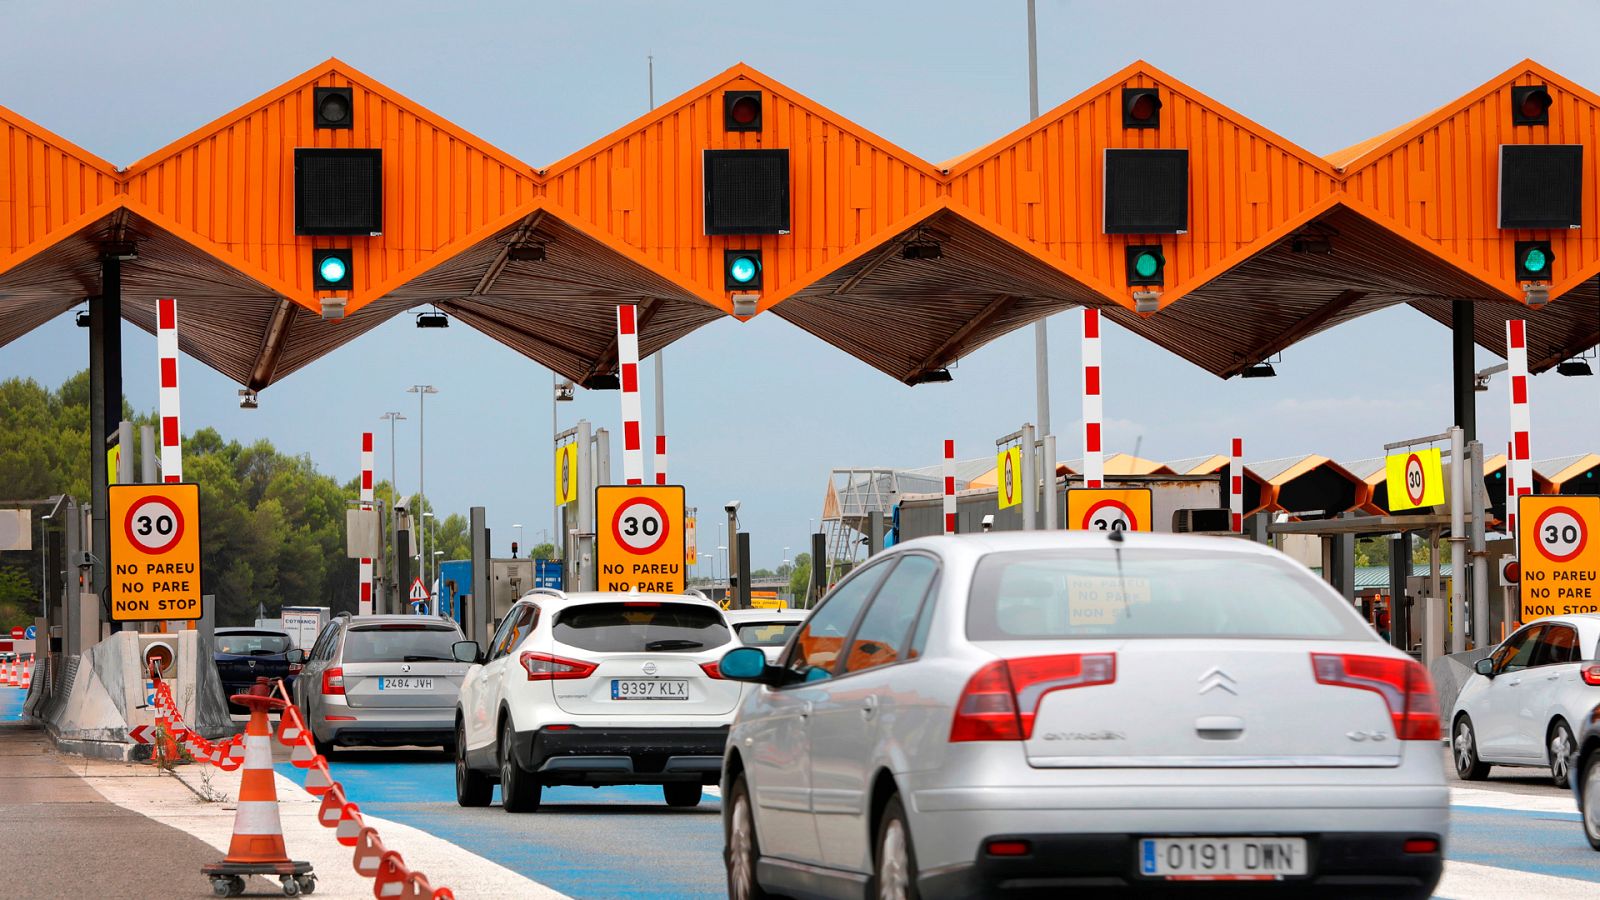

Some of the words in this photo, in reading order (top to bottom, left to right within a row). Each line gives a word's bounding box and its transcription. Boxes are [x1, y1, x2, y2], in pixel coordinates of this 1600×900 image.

[1409, 470, 1421, 488] 30
[137, 515, 173, 536] 30
[623, 516, 659, 536] 30
[1545, 525, 1577, 544] 30
[116, 564, 138, 575] NO
[147, 563, 195, 574] PAREU
[603, 564, 624, 574] NO
[633, 564, 679, 574] PAREU
[1525, 571, 1545, 581] NO
[1553, 571, 1597, 581] PAREU
[122, 582, 144, 593] NO
[153, 581, 190, 592] PARE
[608, 582, 629, 592] NO
[638, 582, 674, 592] PARE
[1531, 588, 1550, 598] NO
[1558, 588, 1592, 598] PARE
[116, 600, 149, 611] NON
[158, 599, 197, 610] STOP
[1525, 606, 1555, 615] NON
[1563, 606, 1598, 615] STOP
[385, 679, 409, 688] 2484
[414, 679, 432, 688] JVH
[621, 682, 655, 694] 9397
[660, 682, 685, 694] KLX
[1166, 844, 1231, 869] 0191
[1244, 844, 1293, 869] DWN
